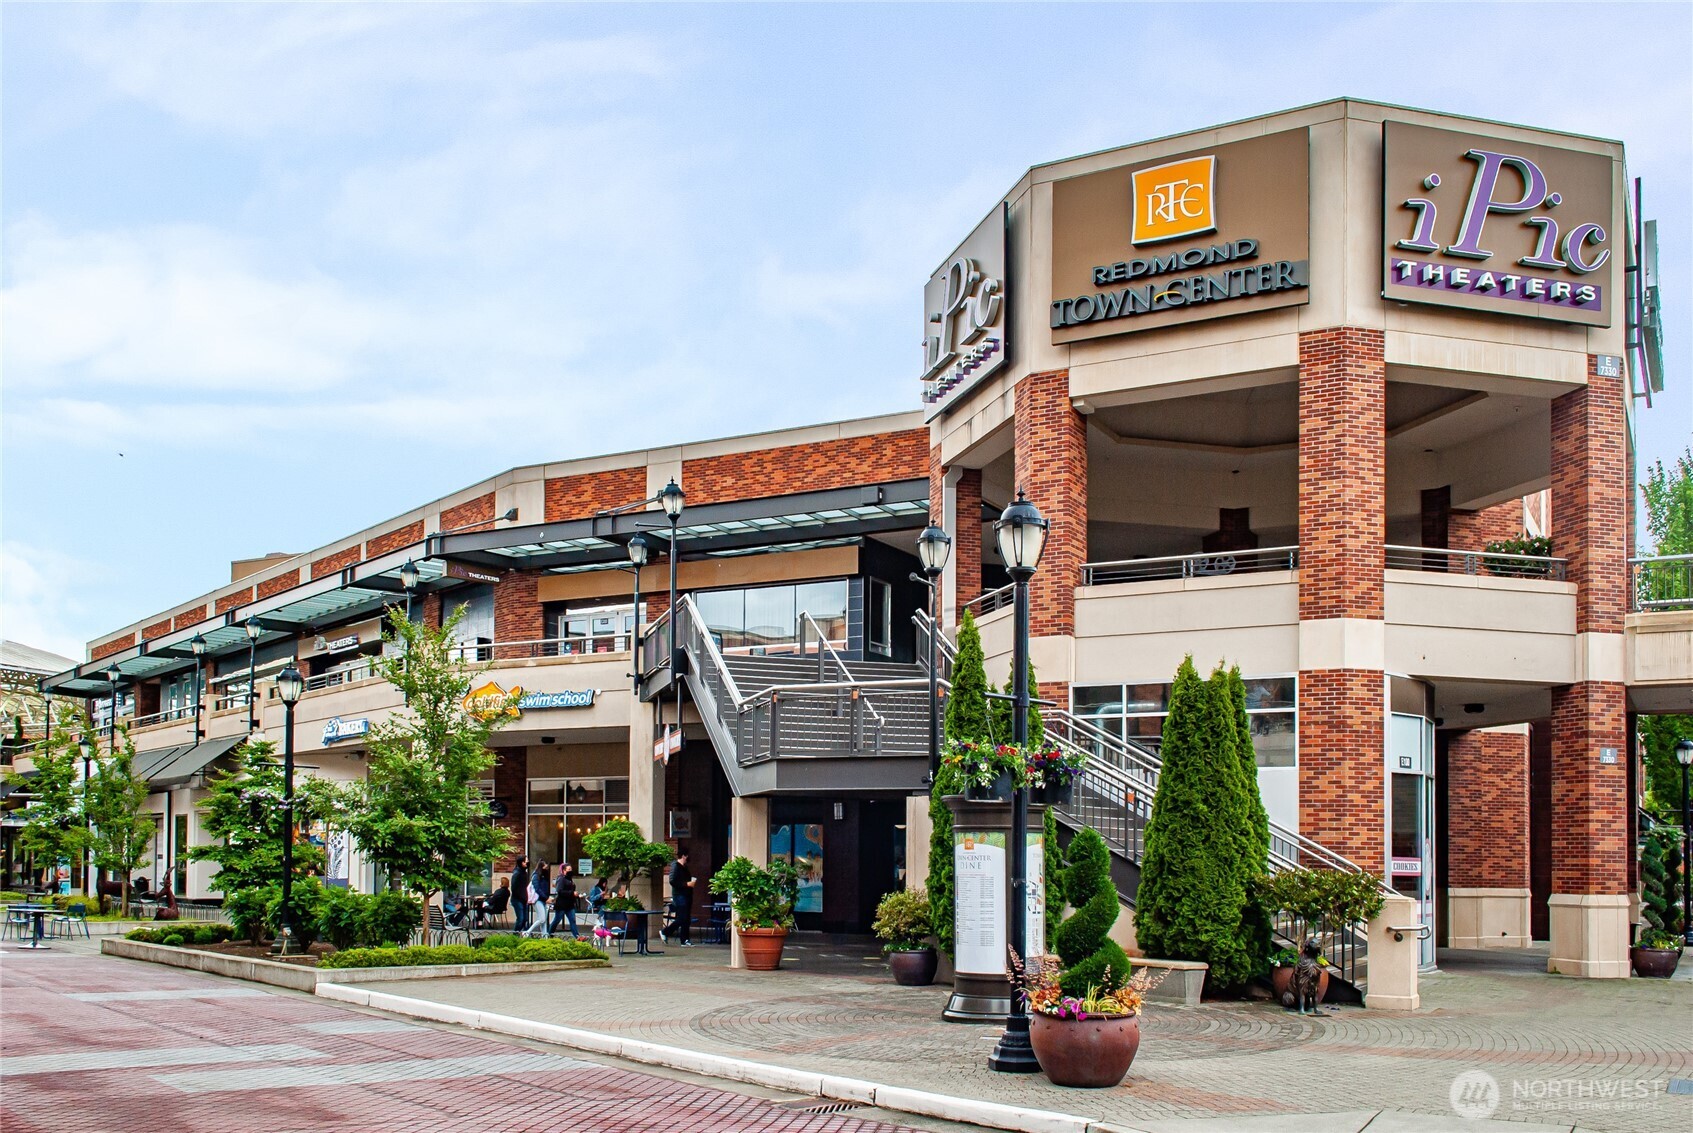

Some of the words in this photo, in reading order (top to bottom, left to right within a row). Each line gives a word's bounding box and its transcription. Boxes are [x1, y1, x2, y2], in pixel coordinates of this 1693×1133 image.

[1146, 178, 1204, 226] RTC
[1395, 148, 1610, 274] iPic
[1092, 238, 1259, 286] REDMOND
[1396, 260, 1597, 304] THEATERS
[1051, 284, 1155, 326] TOWN
[1162, 260, 1304, 308] CENTER
[920, 257, 1001, 380] iPic
[1600, 365, 1618, 377] 7330
[1605, 356, 1612, 367] E
[468, 572, 500, 583] THEATERS
[519, 692, 550, 708] swim
[551, 689, 593, 706] school
[1393, 862, 1419, 871] COOKIES
